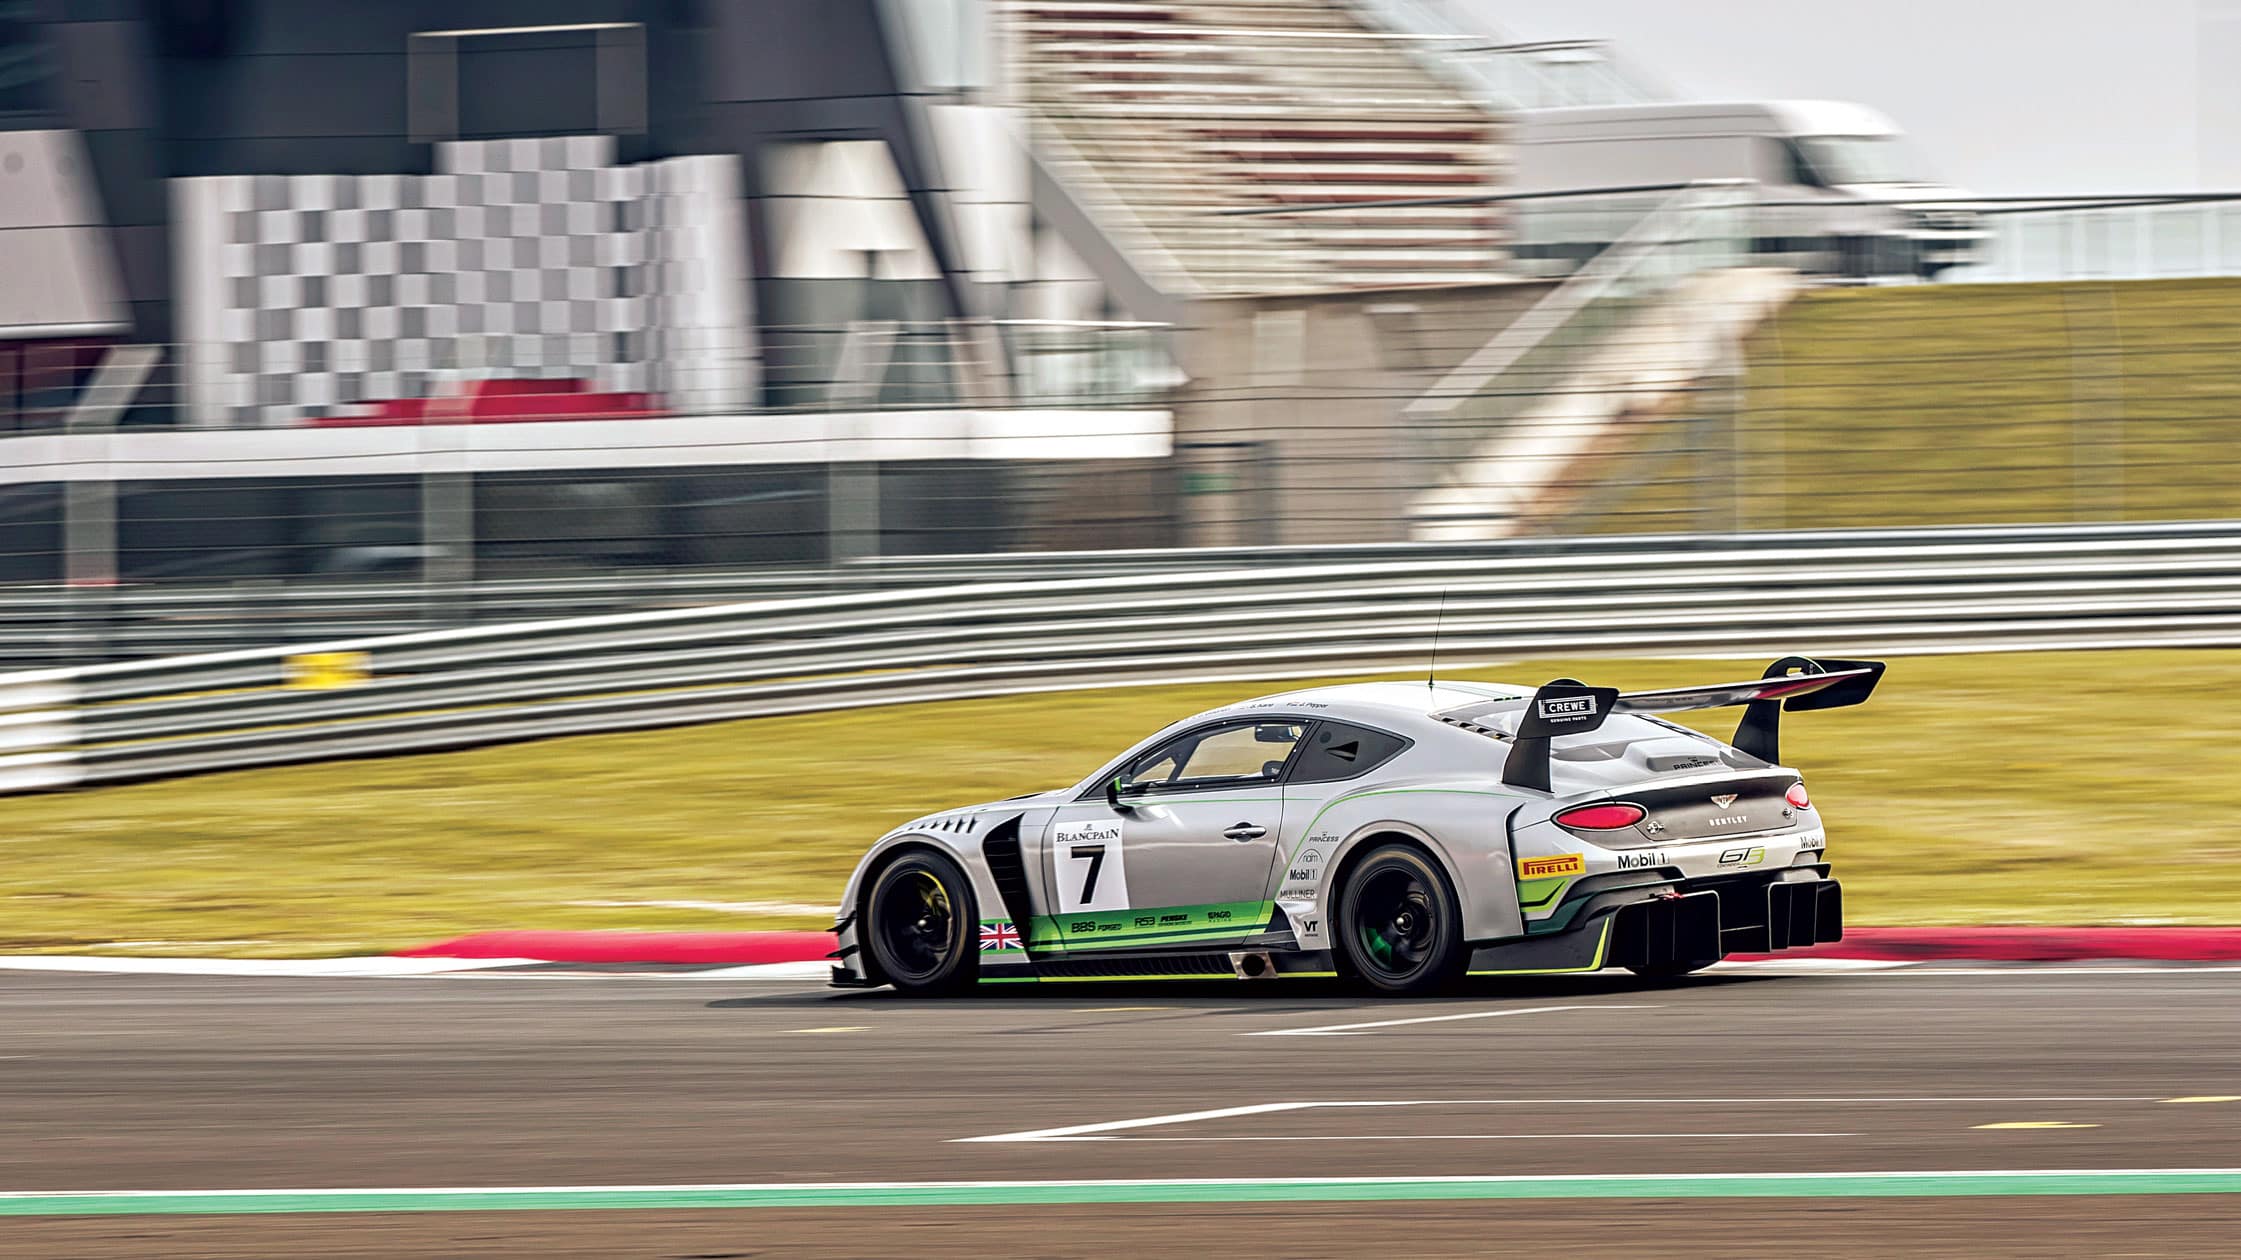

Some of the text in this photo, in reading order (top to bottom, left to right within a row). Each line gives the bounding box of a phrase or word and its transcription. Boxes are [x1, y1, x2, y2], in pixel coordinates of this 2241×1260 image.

[1549, 701, 1586, 713] CREWE
[1709, 815, 1747, 827] BENTLEY
[1056, 828, 1119, 842] BLANCPAIN
[1523, 857, 1578, 875] PIRELLI
[1618, 853, 1656, 869] Mobil
[1070, 844, 1105, 905] 7
[1290, 869, 1310, 880] Mobil
[1280, 889, 1316, 899] MULLINER
[1071, 921, 1096, 933] BBS
[1304, 921, 1318, 932] VT
